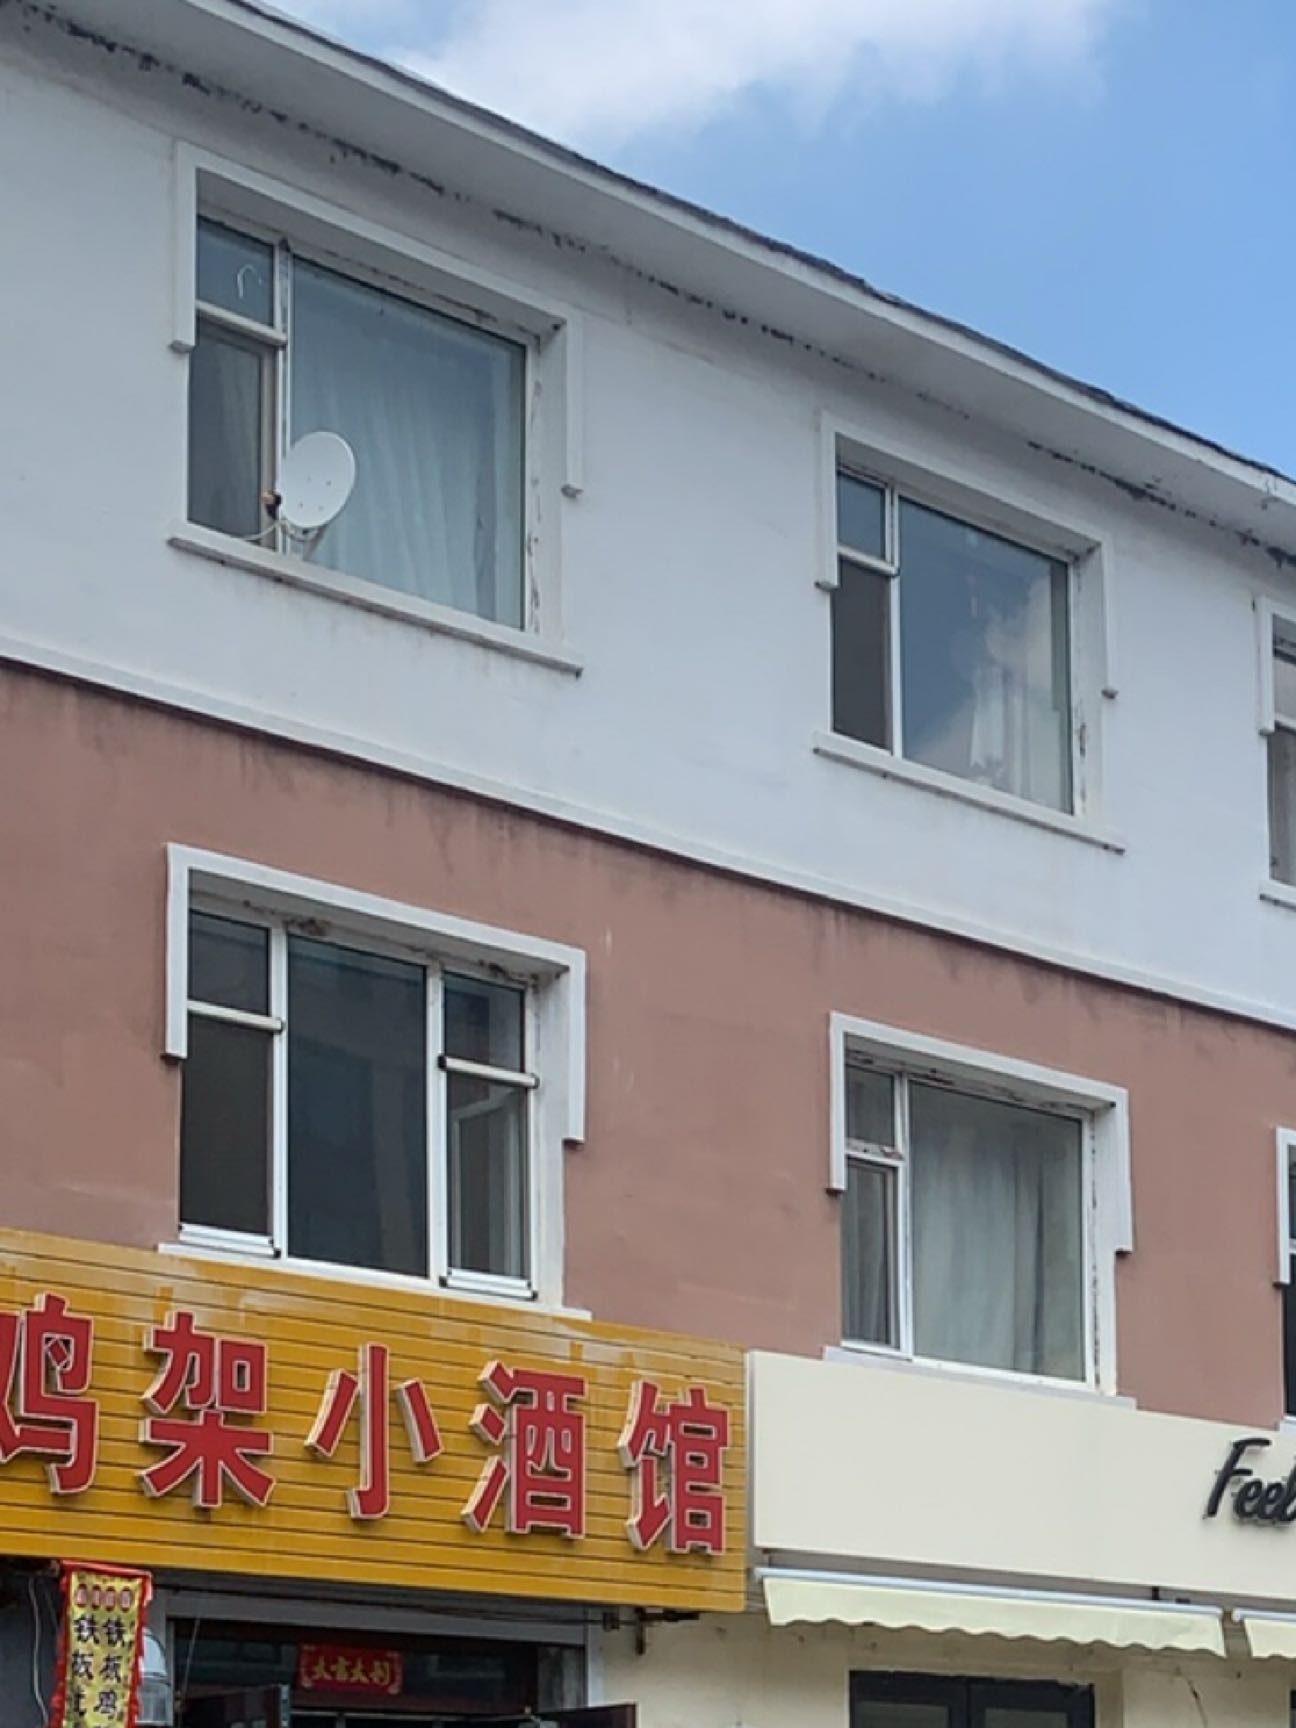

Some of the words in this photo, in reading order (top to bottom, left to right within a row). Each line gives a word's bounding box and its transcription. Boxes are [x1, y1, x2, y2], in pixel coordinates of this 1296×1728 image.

[0, 1291, 729, 1556] 鸡架小酒馆
